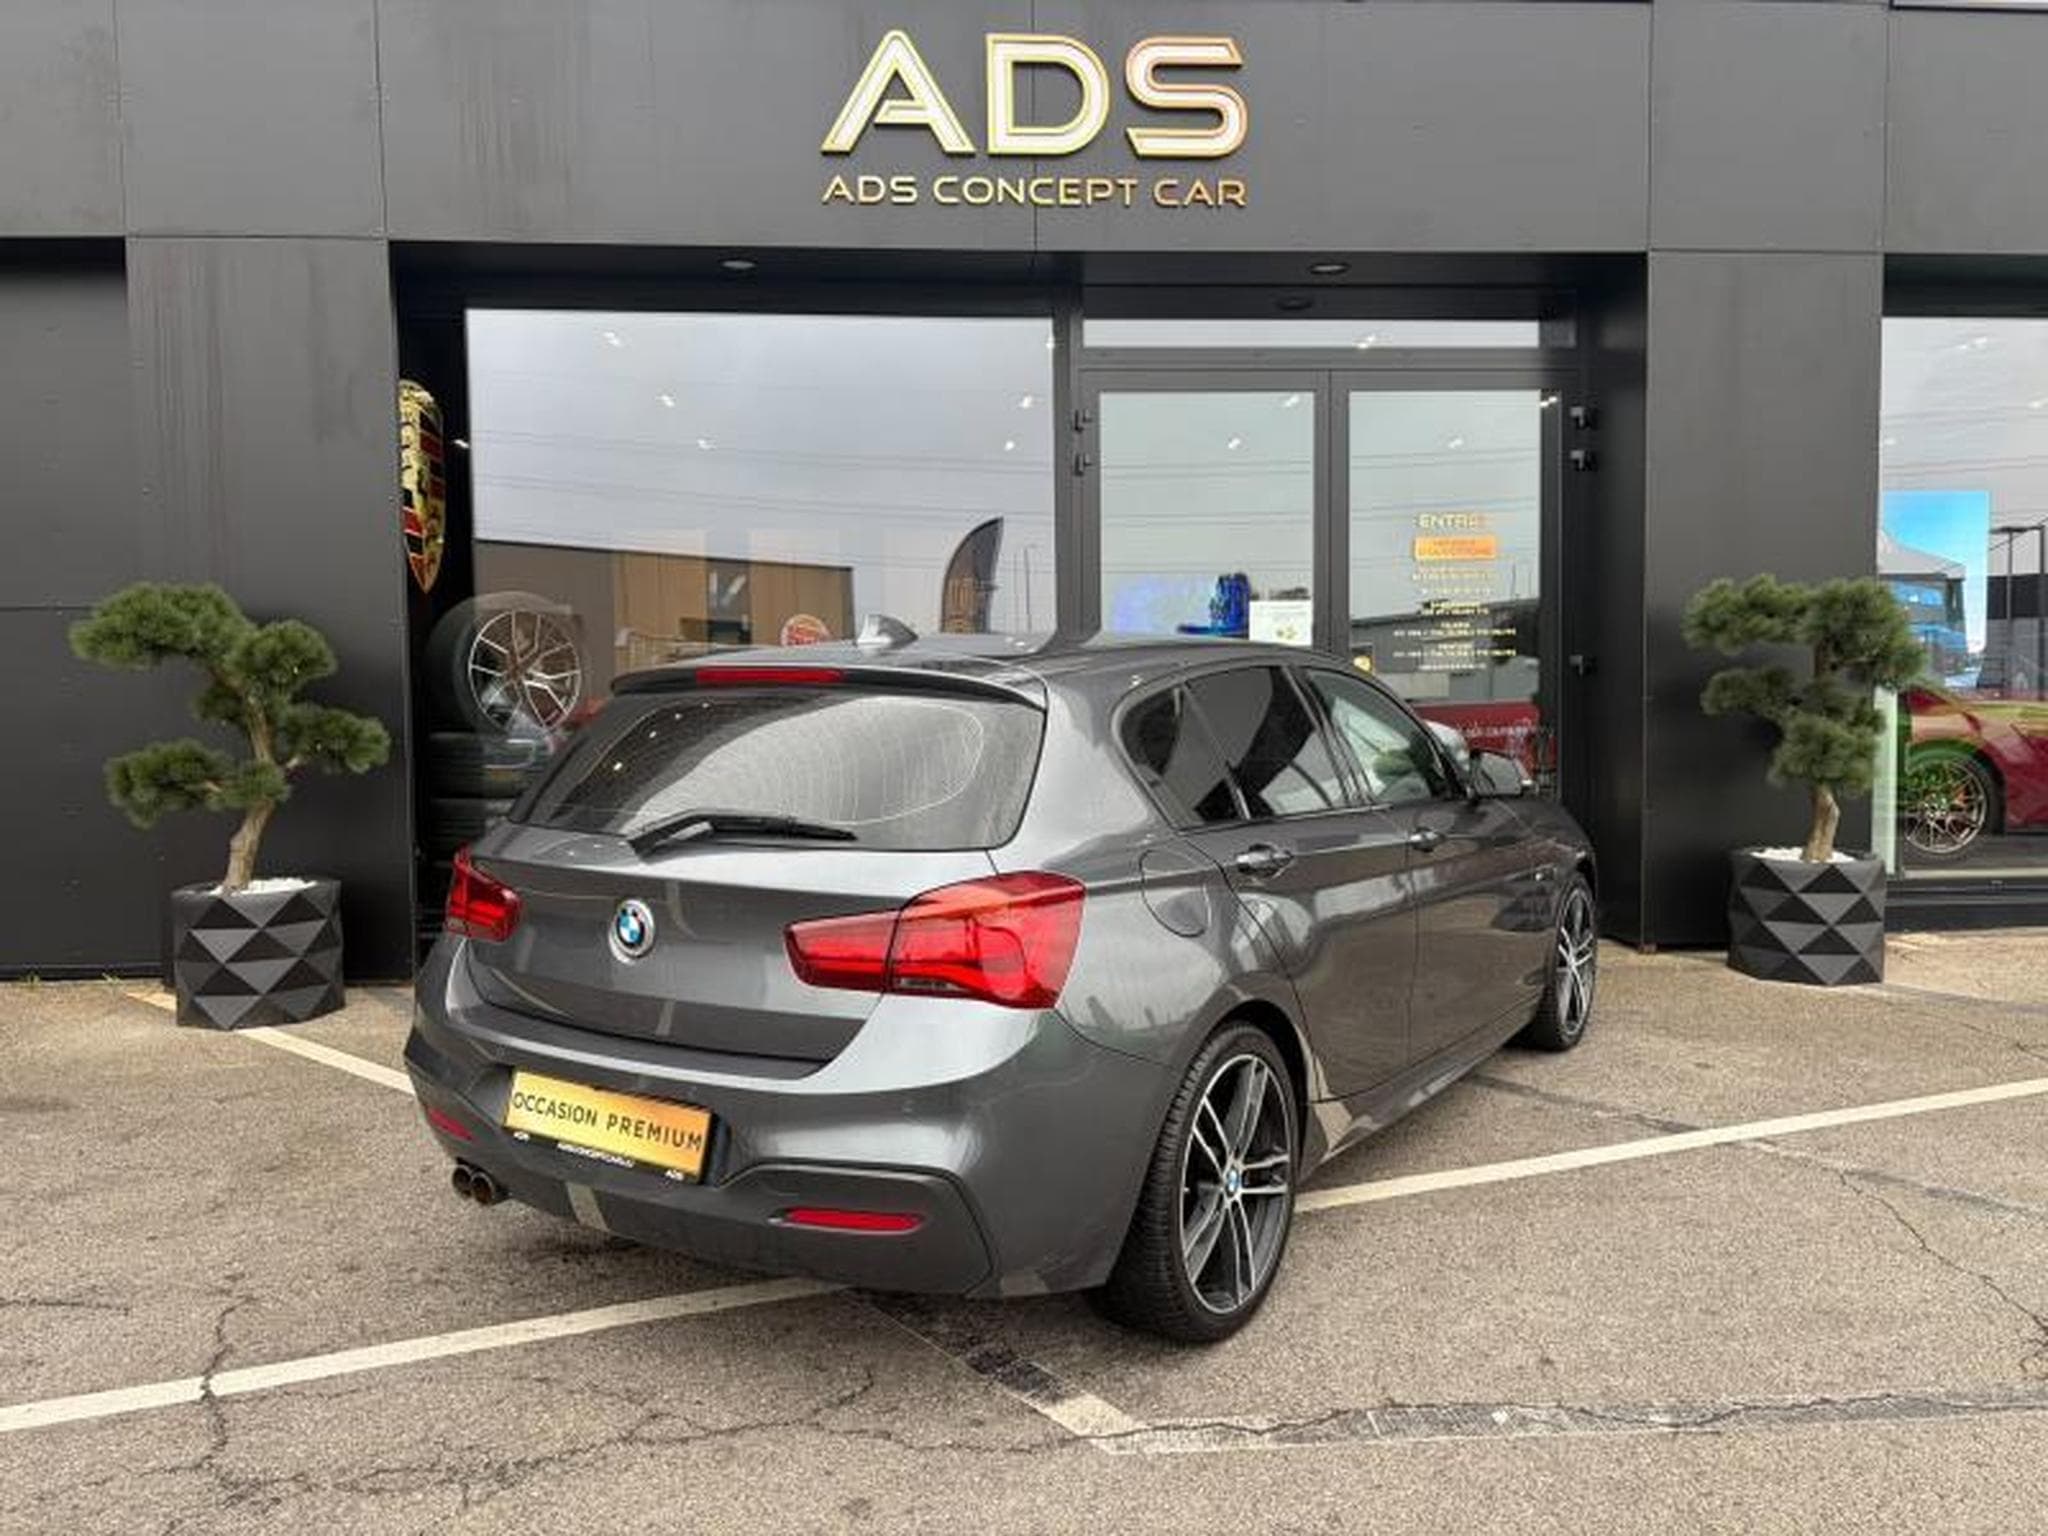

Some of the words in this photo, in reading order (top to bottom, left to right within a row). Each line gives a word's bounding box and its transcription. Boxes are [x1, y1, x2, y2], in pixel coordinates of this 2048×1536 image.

[821, 29, 1249, 157] ADS
[822, 175, 918, 205] ADS
[933, 176, 1139, 206] CONCEPT
[1153, 180, 1248, 208] CAR
[512, 1091, 598, 1127] OCCASION
[606, 1112, 702, 1151] PREMIUM
